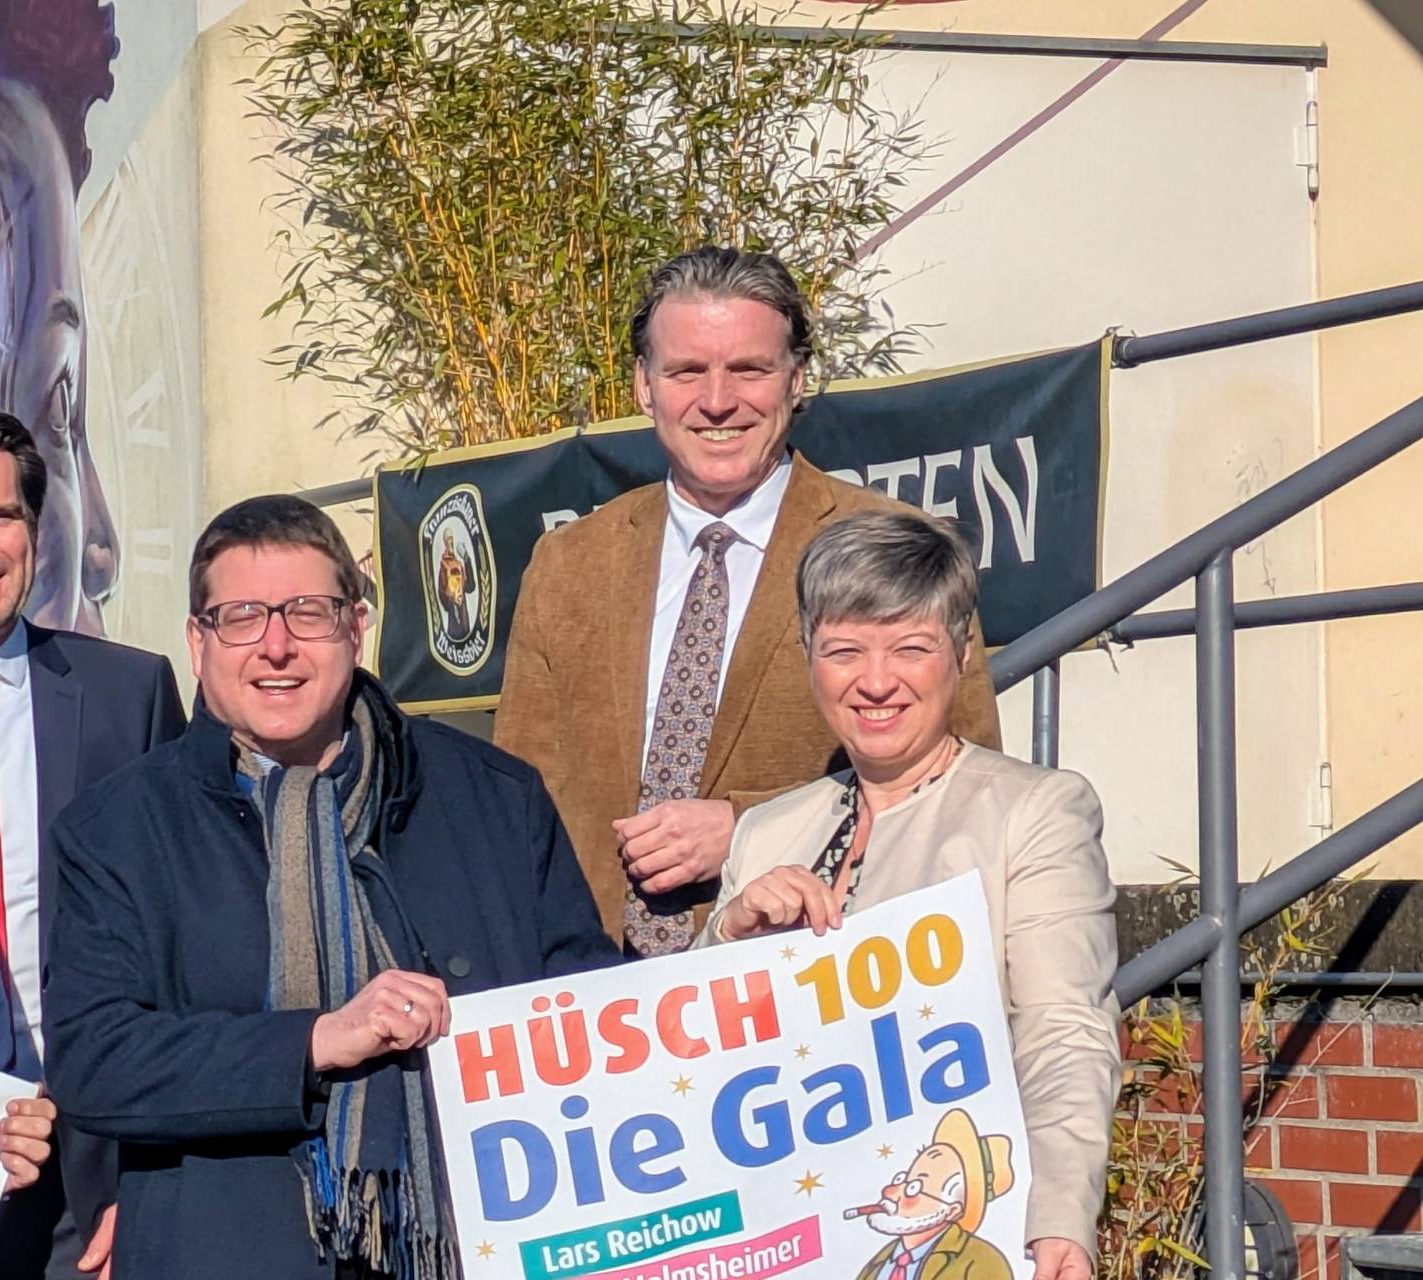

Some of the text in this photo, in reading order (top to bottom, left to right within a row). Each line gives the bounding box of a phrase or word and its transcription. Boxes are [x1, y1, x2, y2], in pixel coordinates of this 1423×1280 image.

[453, 913, 965, 1104] HÜSCH 100
[470, 1011, 992, 1222] Die Gala
[541, 1207, 723, 1273] Lars Reichow
